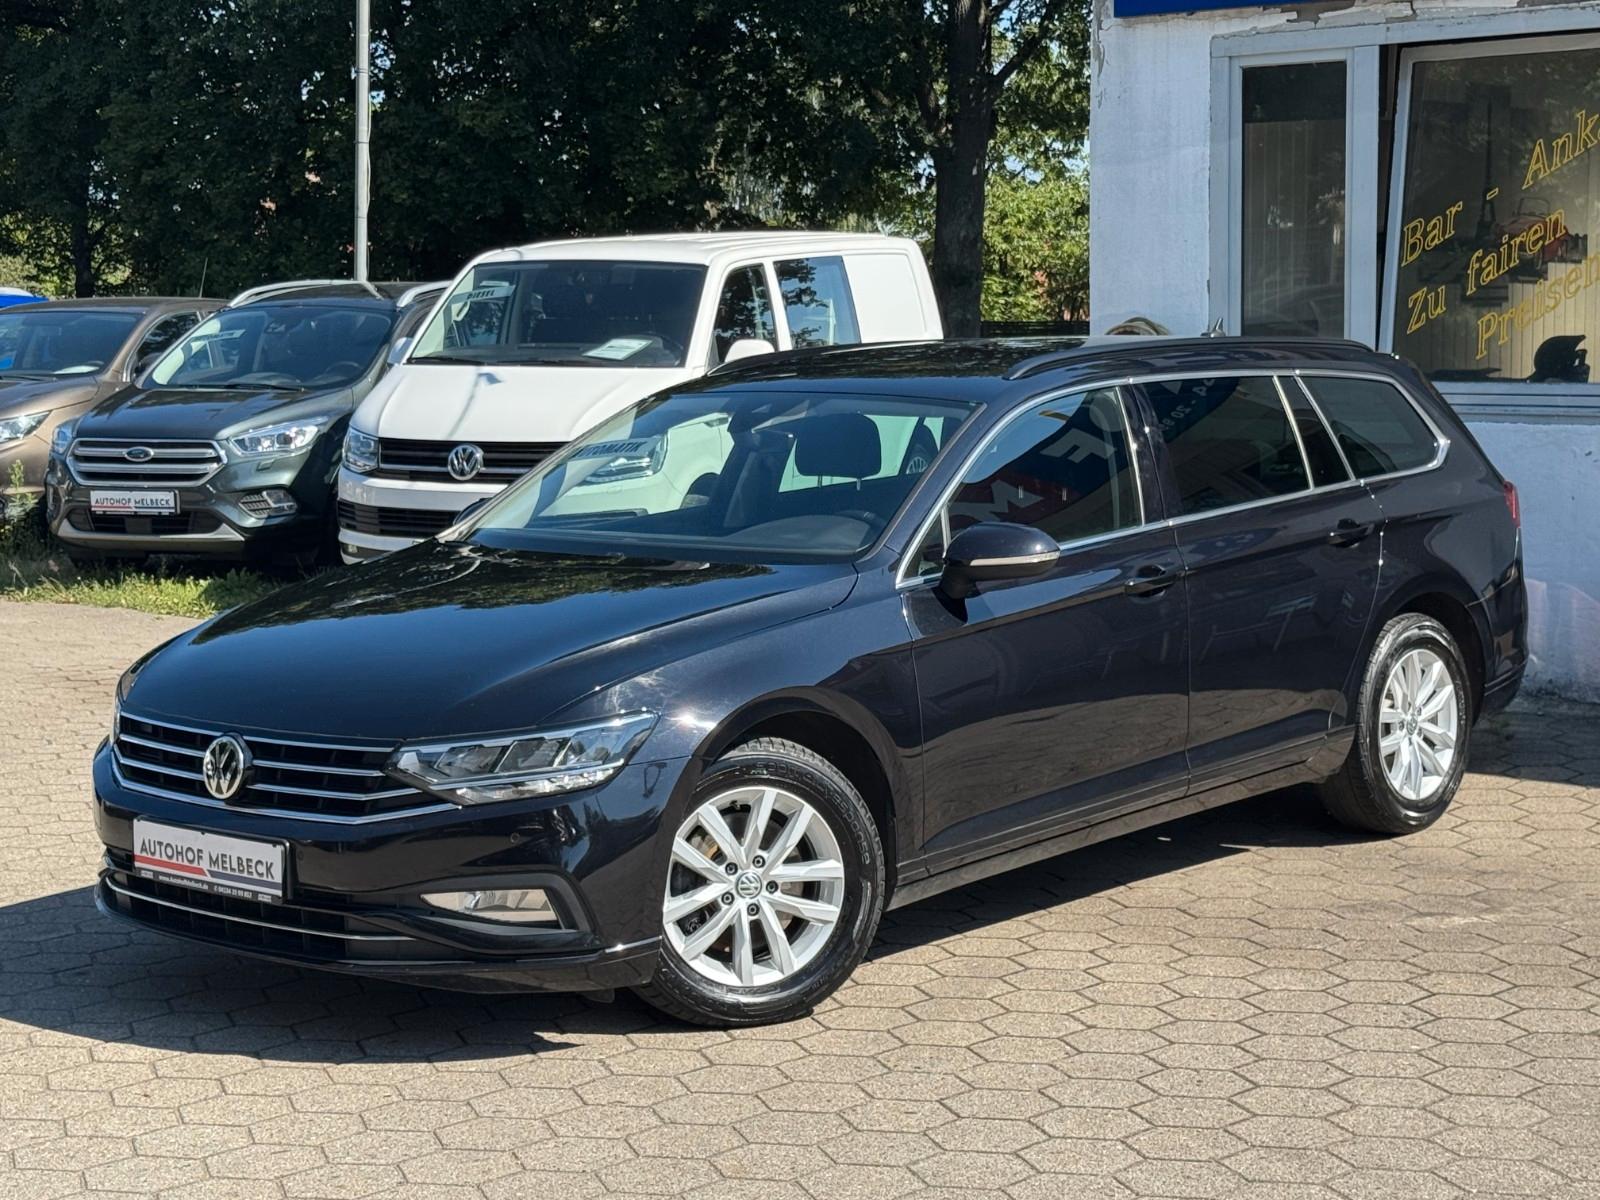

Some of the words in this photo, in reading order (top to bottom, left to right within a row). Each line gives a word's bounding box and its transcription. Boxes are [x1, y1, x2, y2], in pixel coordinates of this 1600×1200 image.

[1400, 200, 1463, 268] Bar
[1521, 109, 1600, 190] Ank
[1406, 286, 1447, 335] Zu
[1465, 207, 1566, 297] fairen
[94, 497, 132, 506] AUTOHOF
[134, 497, 171, 506] MELBECK
[140, 837, 204, 867] AUTOHOF
[208, 850, 275, 880] MELBECK
